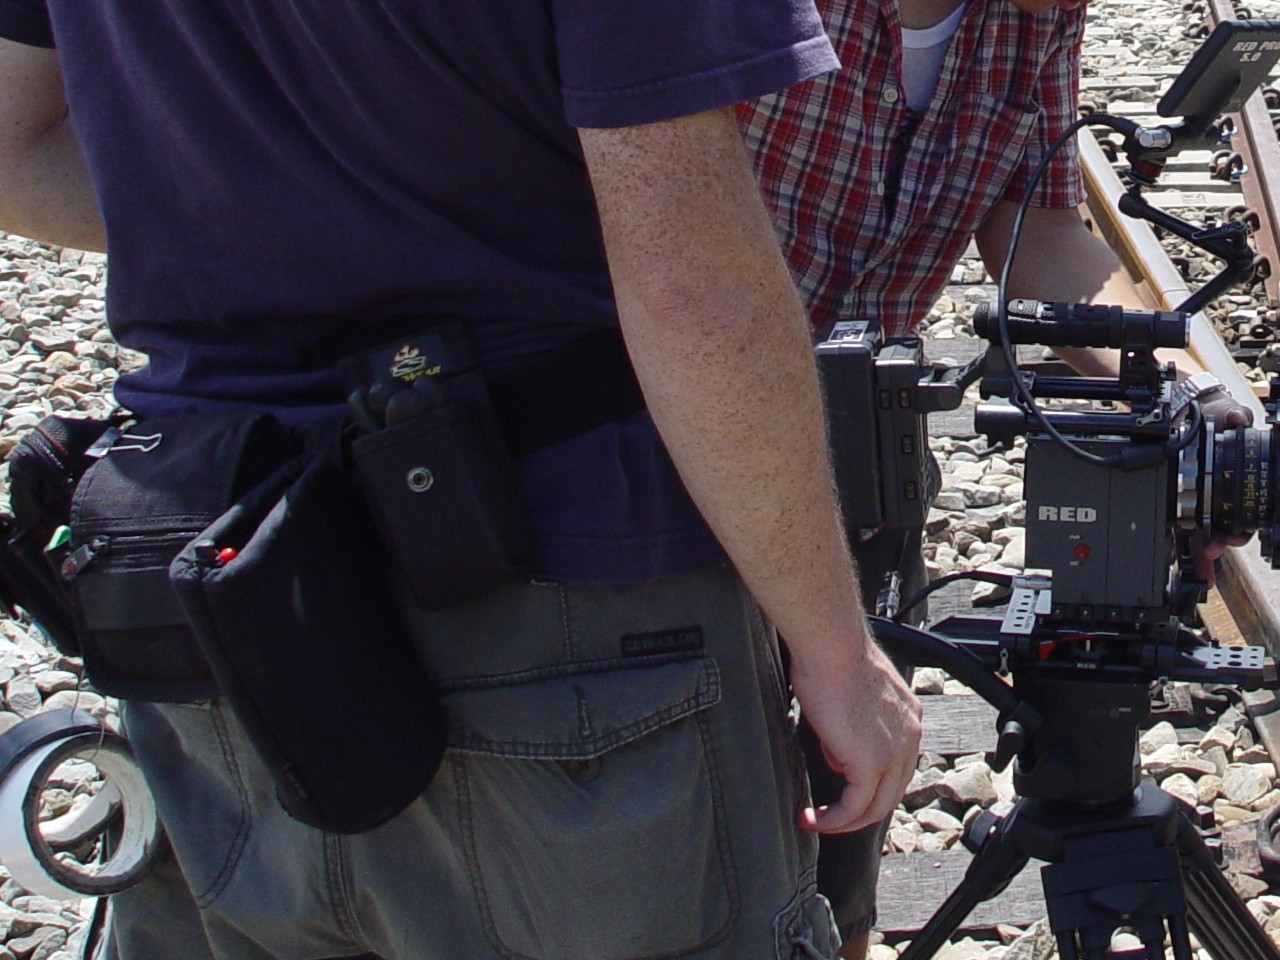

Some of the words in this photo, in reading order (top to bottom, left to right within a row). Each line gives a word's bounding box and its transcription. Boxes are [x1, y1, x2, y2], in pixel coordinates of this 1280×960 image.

[1232, 41, 1259, 52] RED
[1240, 52, 1262, 62] 5.0
[1038, 506, 1096, 523] RED
